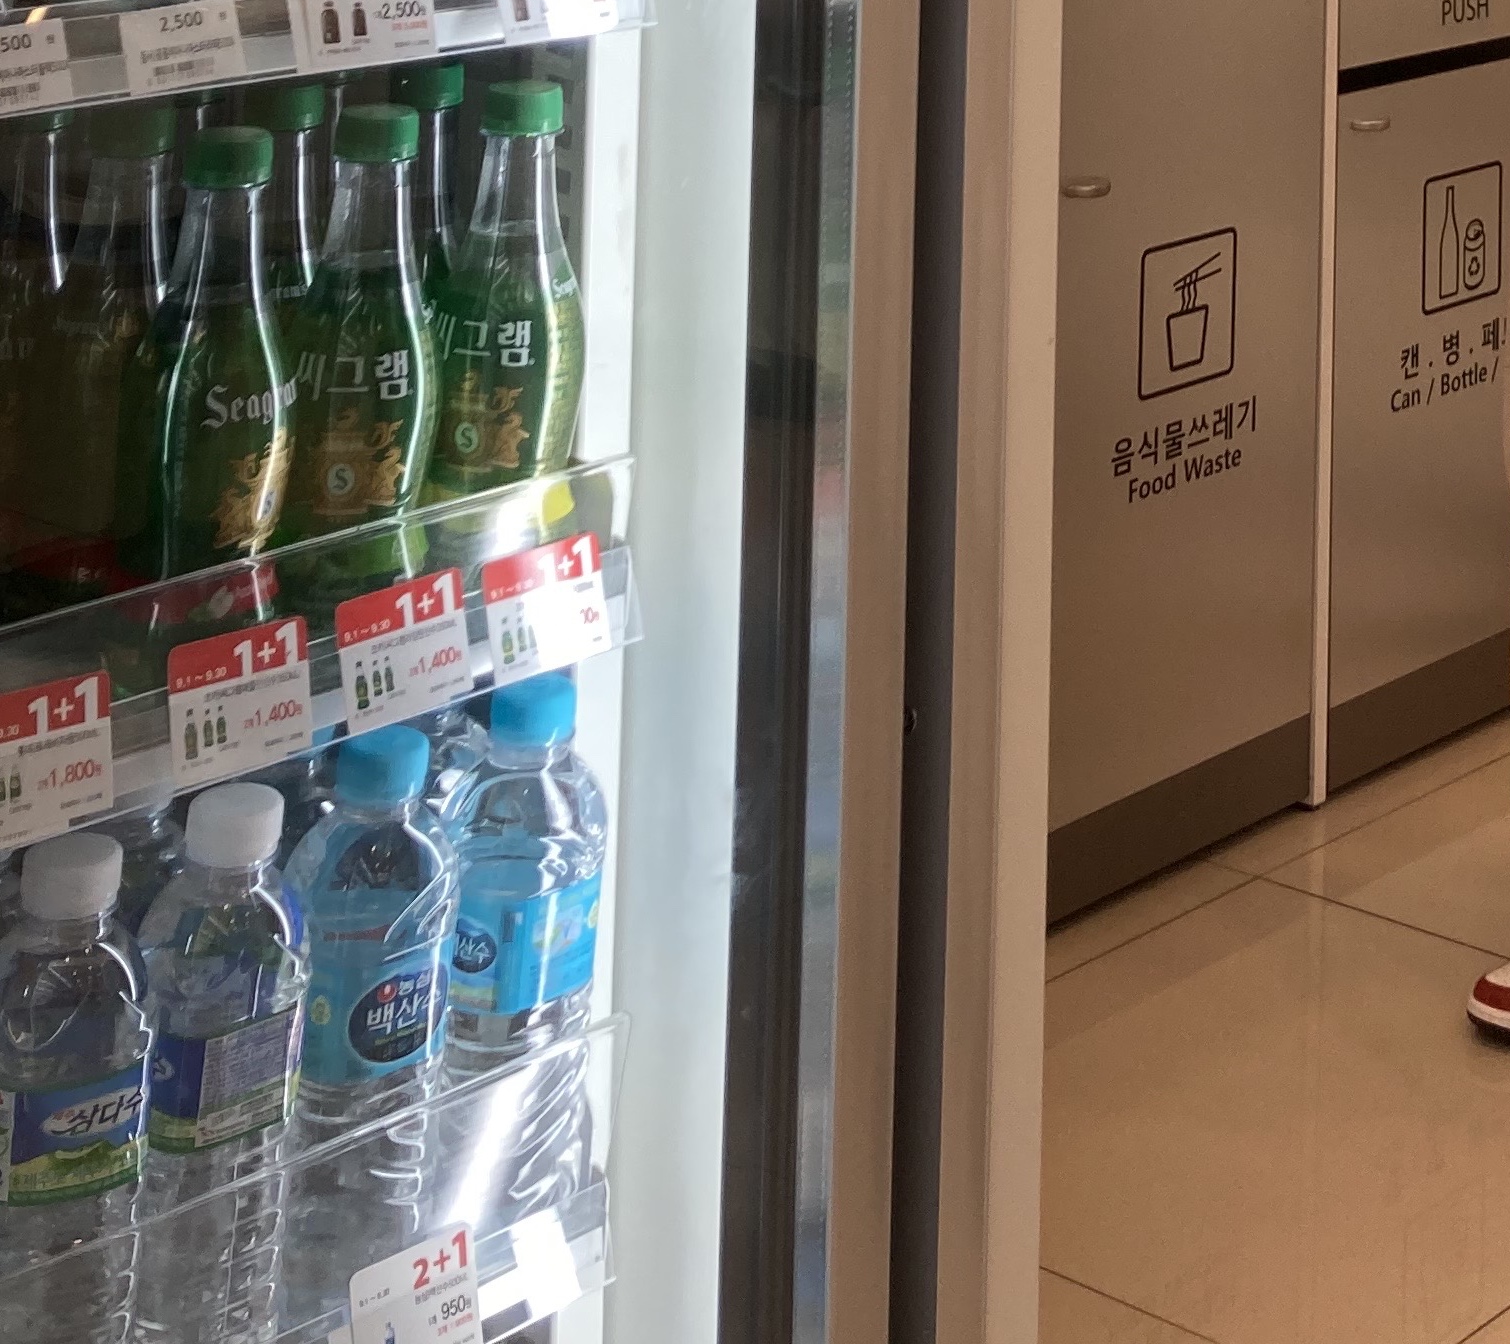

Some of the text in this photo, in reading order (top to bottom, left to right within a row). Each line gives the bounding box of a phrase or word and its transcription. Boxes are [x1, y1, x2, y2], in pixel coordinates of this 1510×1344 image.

[1391, 387, 1421, 413] Can
[1440, 361, 1488, 397] Bottle
[1111, 394, 1257, 478] 음식물쓰레기
[1128, 447, 1243, 504] Food Waste
[537, 534, 597, 587] 1+1
[395, 572, 457, 628] 1+1
[232, 620, 300, 678] 1+1
[27, 675, 100, 740] 1+1
[412, 1229, 469, 1291] 2+1
